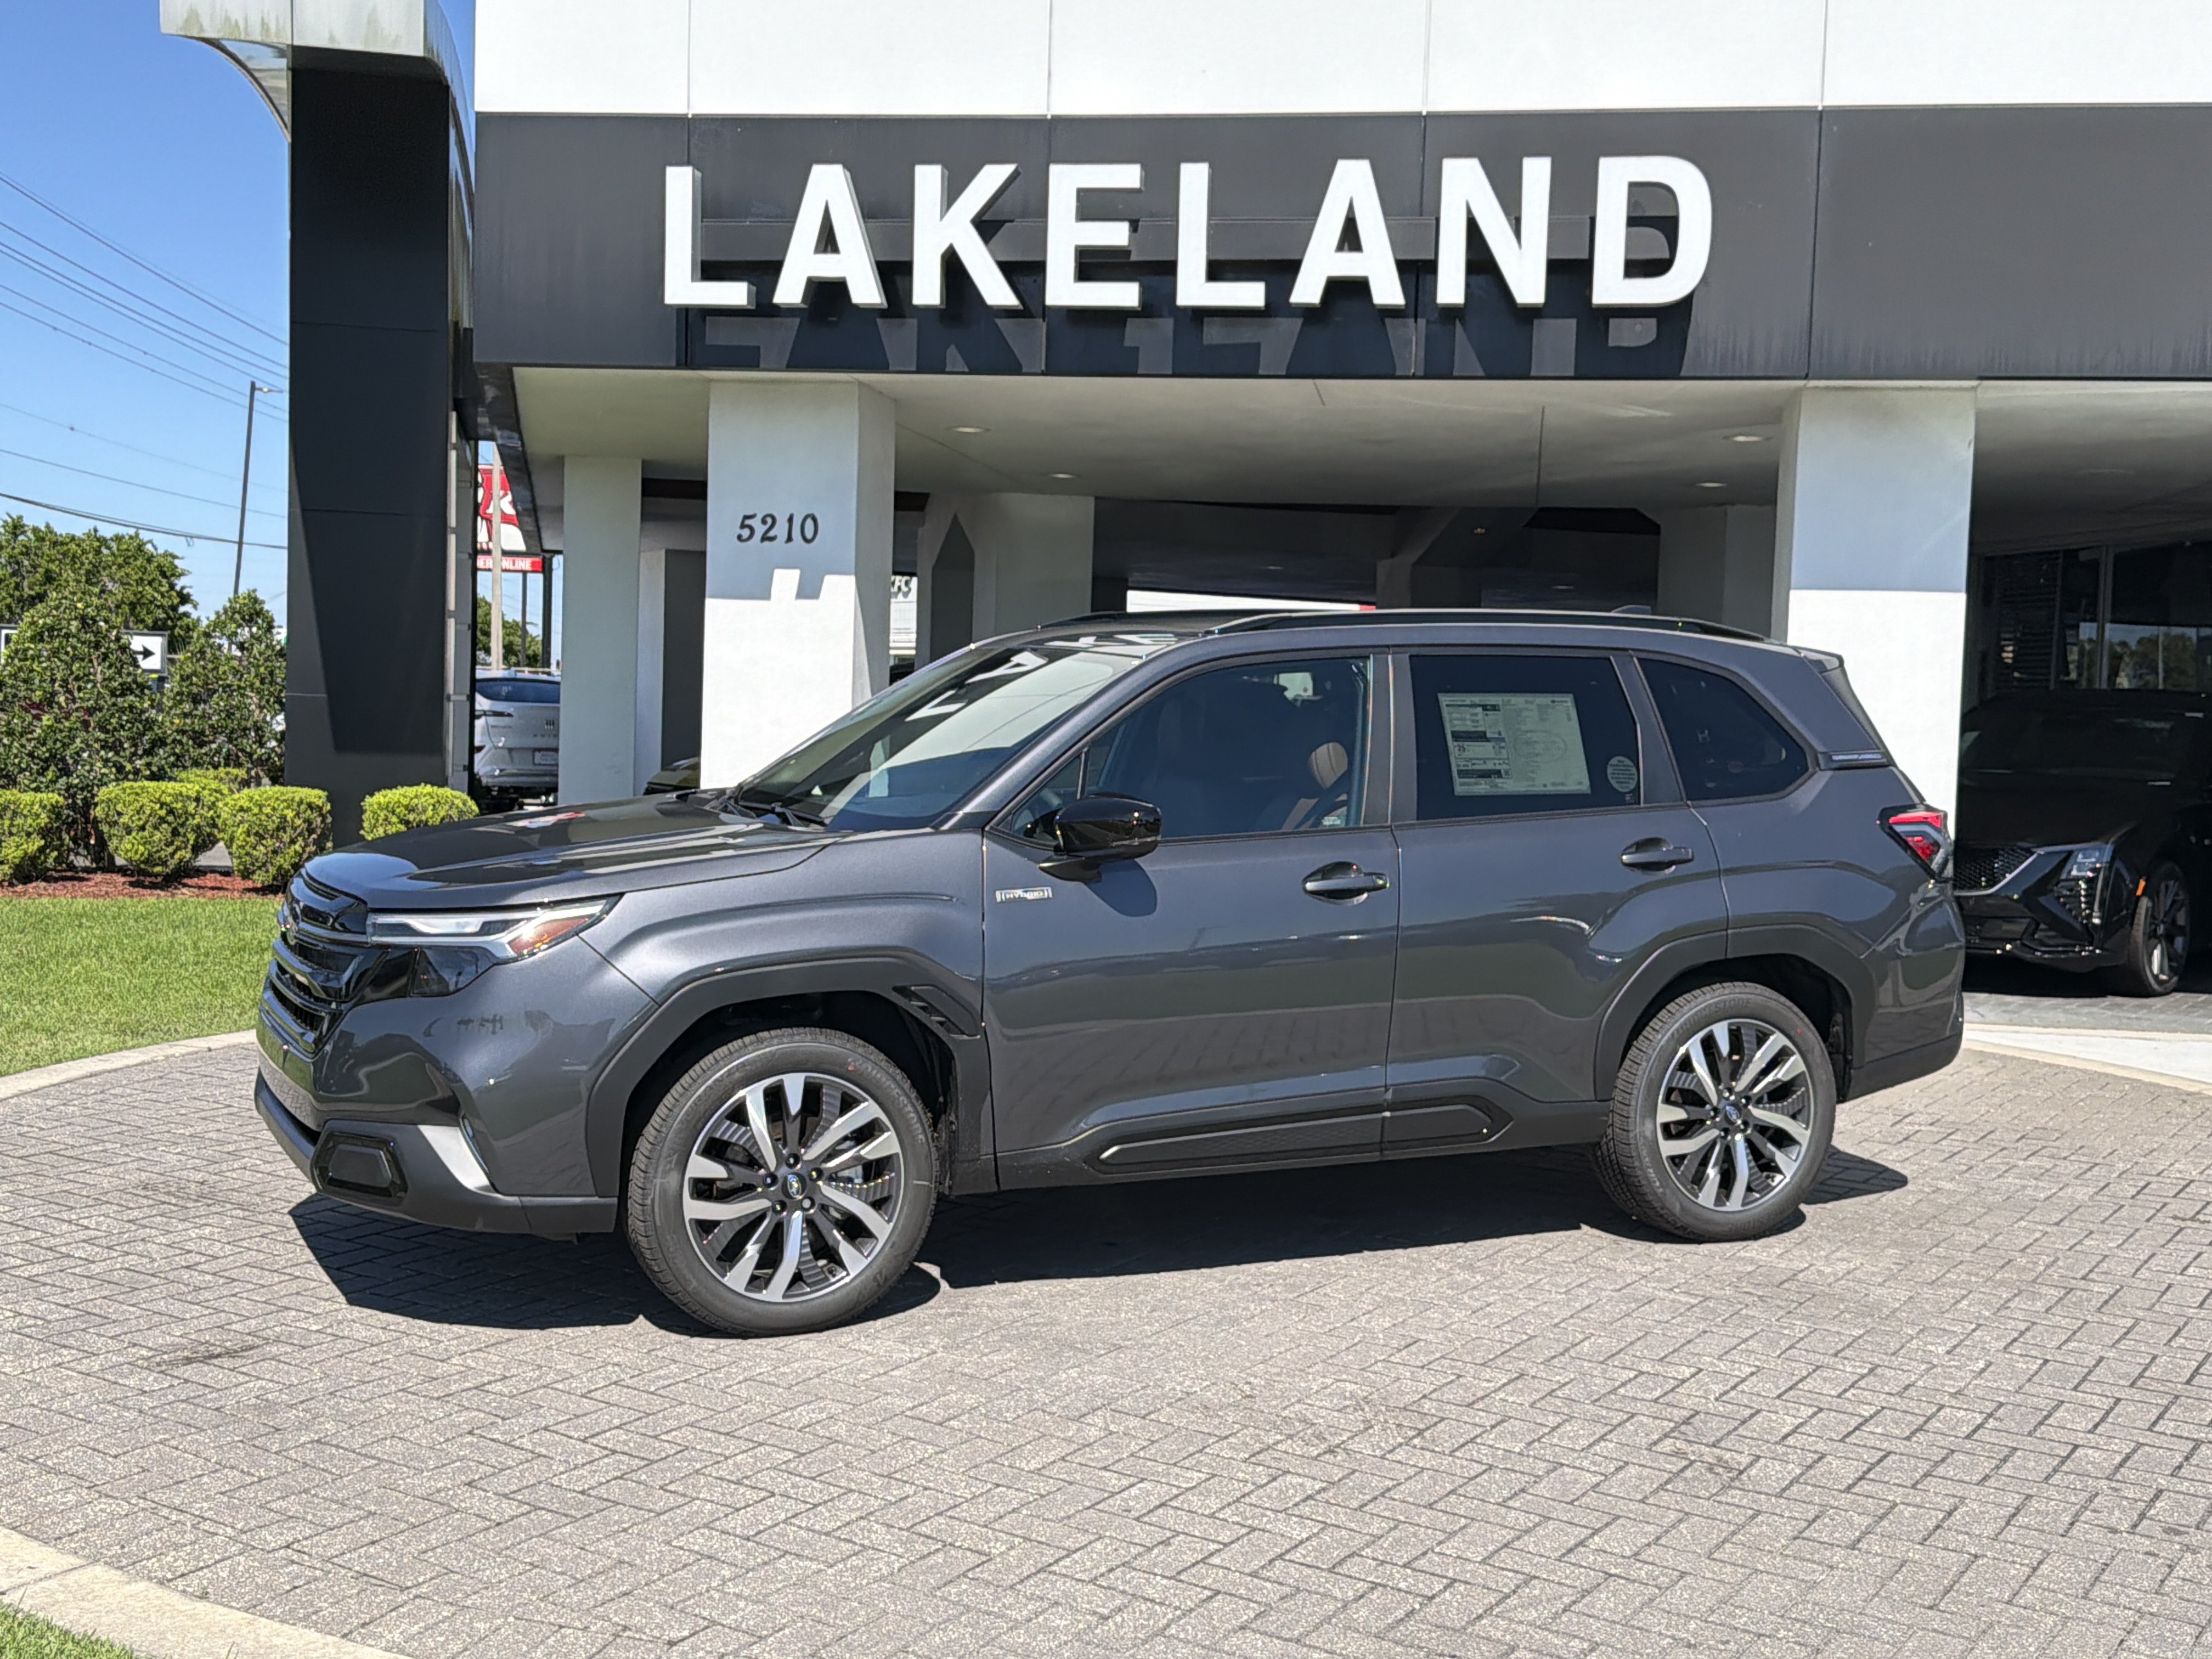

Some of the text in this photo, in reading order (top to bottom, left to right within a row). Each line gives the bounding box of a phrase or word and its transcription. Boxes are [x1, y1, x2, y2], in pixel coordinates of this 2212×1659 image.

[664, 155, 1713, 310] LAKELAND
[736, 513, 819, 544] 5210
[501, 558, 532, 570] NLINE
